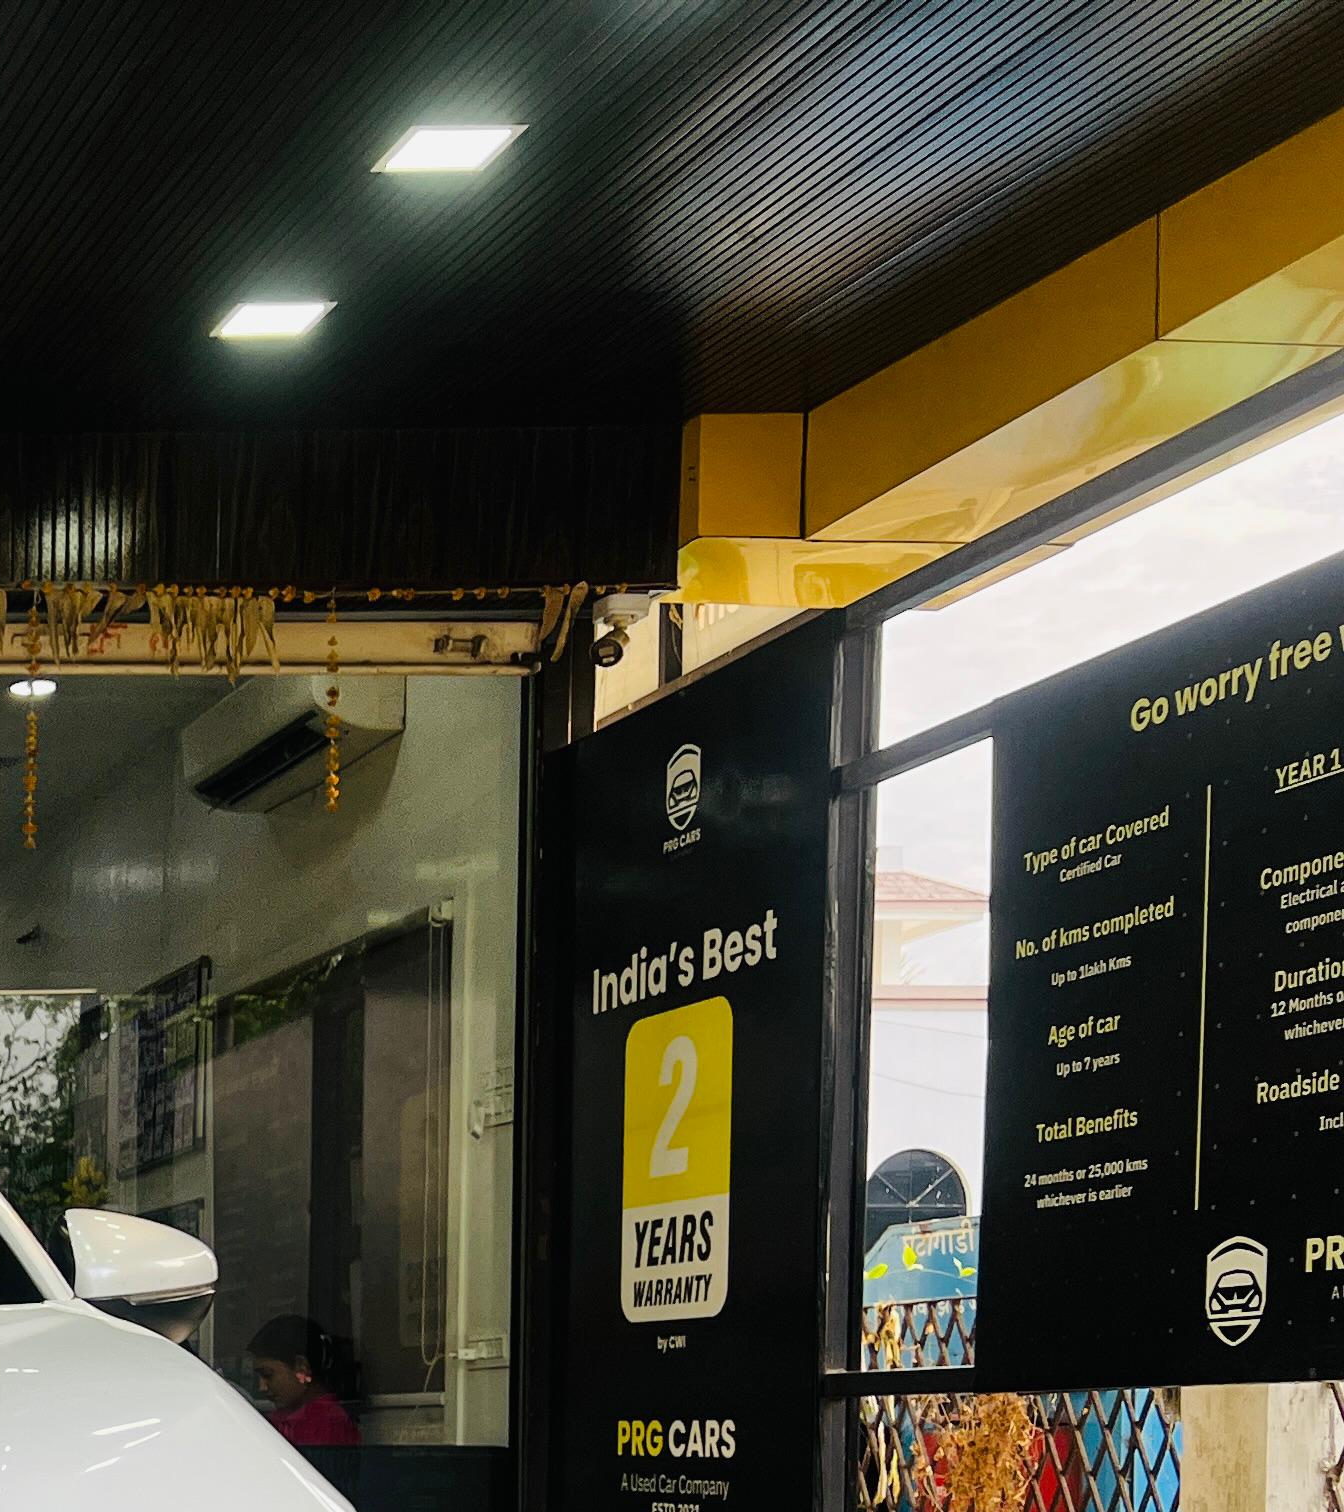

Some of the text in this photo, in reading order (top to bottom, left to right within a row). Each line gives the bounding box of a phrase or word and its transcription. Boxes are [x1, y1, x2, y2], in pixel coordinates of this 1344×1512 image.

[1130, 696, 1169, 732] Go
[1174, 657, 1263, 716] worry
[1269, 631, 1333, 681] free
[1275, 748, 1342, 788] YEAR 1
[1023, 804, 1171, 874] Type of car Covered
[1059, 853, 1123, 882] Certified Car
[1280, 879, 1338, 909] Electrical
[1015, 895, 1175, 960] No. of kms completed
[1285, 908, 1344, 934] compone
[592, 909, 778, 1015] India's Best
[1051, 972, 1065, 988] Up
[1067, 969, 1077, 982] to
[1108, 955, 1132, 972] Kms
[1274, 957, 1344, 993] Duratio
[1270, 1000, 1286, 1018] 12
[1288, 991, 1334, 1014] Months
[1048, 1014, 1121, 1048] Age of car
[1284, 1017, 1344, 1041] whicheve
[1056, 1052, 1121, 1078] Up to 7 years
[1256, 1068, 1340, 1105] Roadside
[649, 1035, 699, 1179] 2
[1036, 1108, 1139, 1143] Total Benefits
[1024, 1158, 1149, 1188] 24 months or 25,000 kms
[1036, 1184, 1134, 1209] whichever is earlier
[633, 1210, 714, 1268] YEARS
[1305, 1235, 1344, 1272] PR
[633, 1273, 712, 1308] WARRANTY
[657, 1336, 668, 1353] by
[617, 1419, 736, 1459] PRG CARS
[620, 1473, 729, 1501] A Used Car Company
